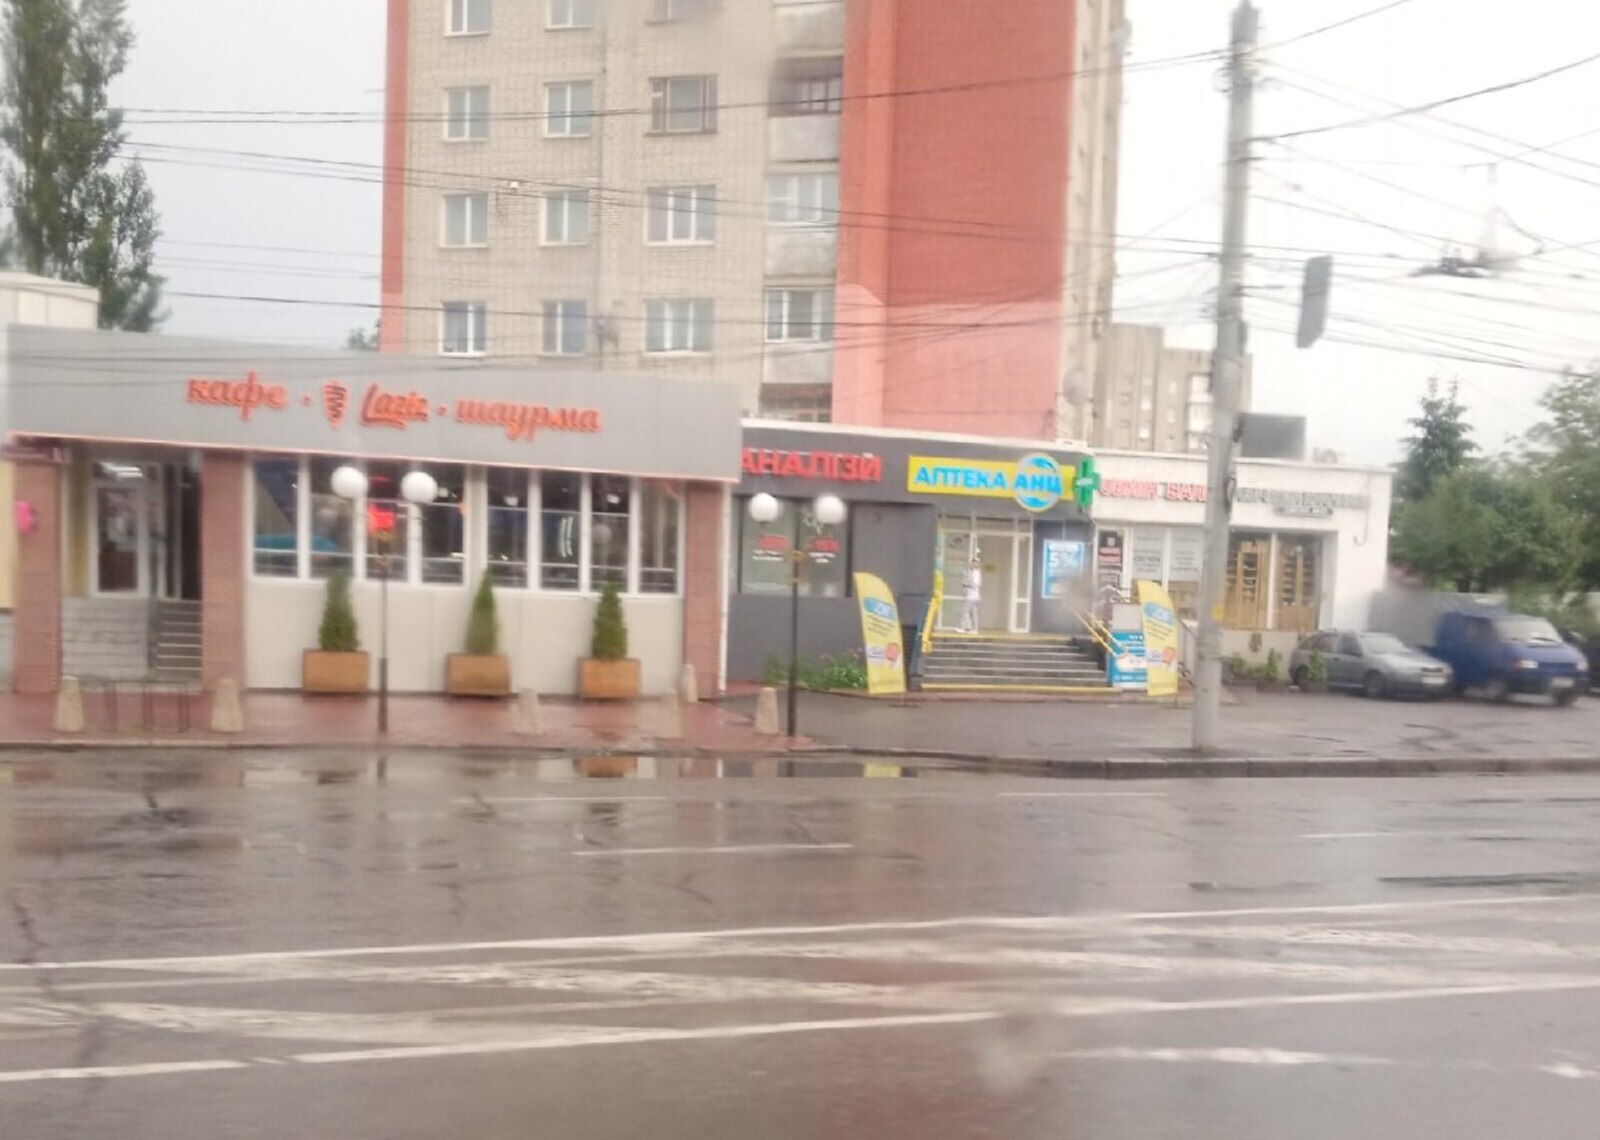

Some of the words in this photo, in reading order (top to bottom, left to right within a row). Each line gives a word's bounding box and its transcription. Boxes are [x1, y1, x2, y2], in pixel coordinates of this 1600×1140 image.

[186, 371, 286, 421] кафе
[455, 399, 602, 440] шаурма
[914, 465, 1008, 490] АПТЕКА
[1013, 473, 1063, 495] АНЦ
